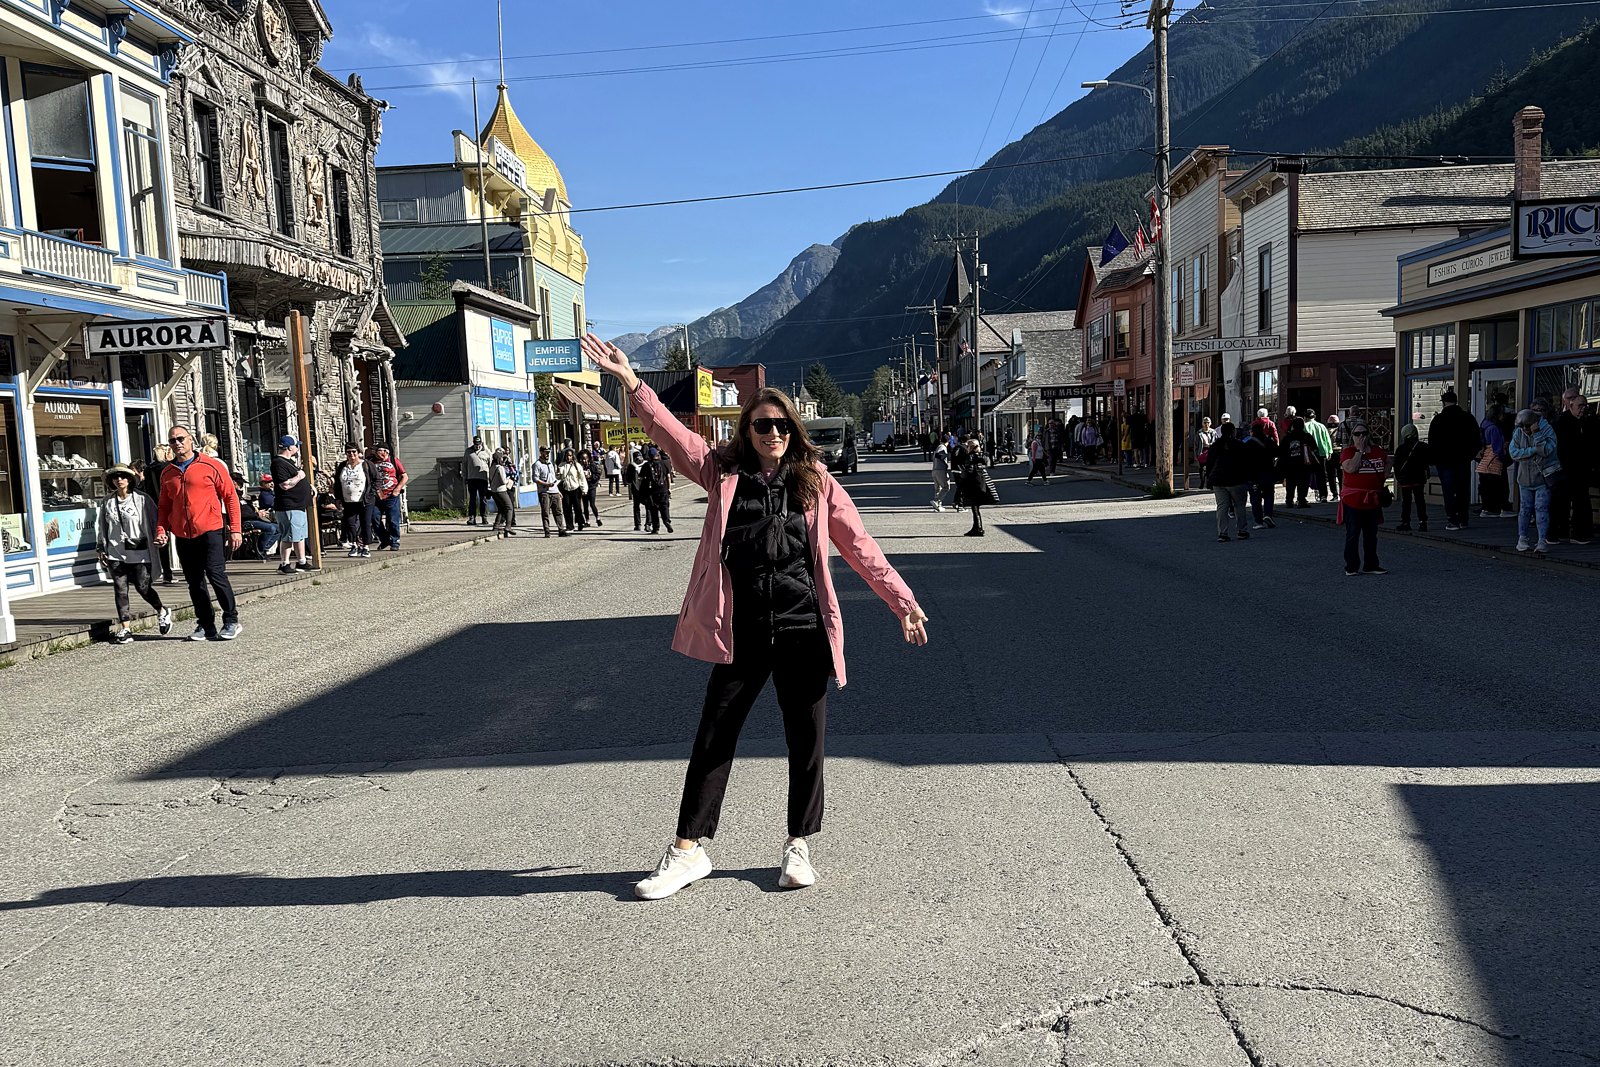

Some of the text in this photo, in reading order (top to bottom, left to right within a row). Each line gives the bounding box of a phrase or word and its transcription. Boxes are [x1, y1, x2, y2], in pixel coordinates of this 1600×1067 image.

[1461, 257, 1483, 271] CURIOS
[99, 324, 217, 348] AURORA
[1180, 337, 1279, 351] FRESH LOCAL ART
[535, 346, 571, 355] EMPIRE
[528, 357, 578, 367] JEWELERS
[1059, 387, 1095, 396] MASCO
[44, 401, 81, 414] AURORA
[607, 426, 639, 438] MINR'S
